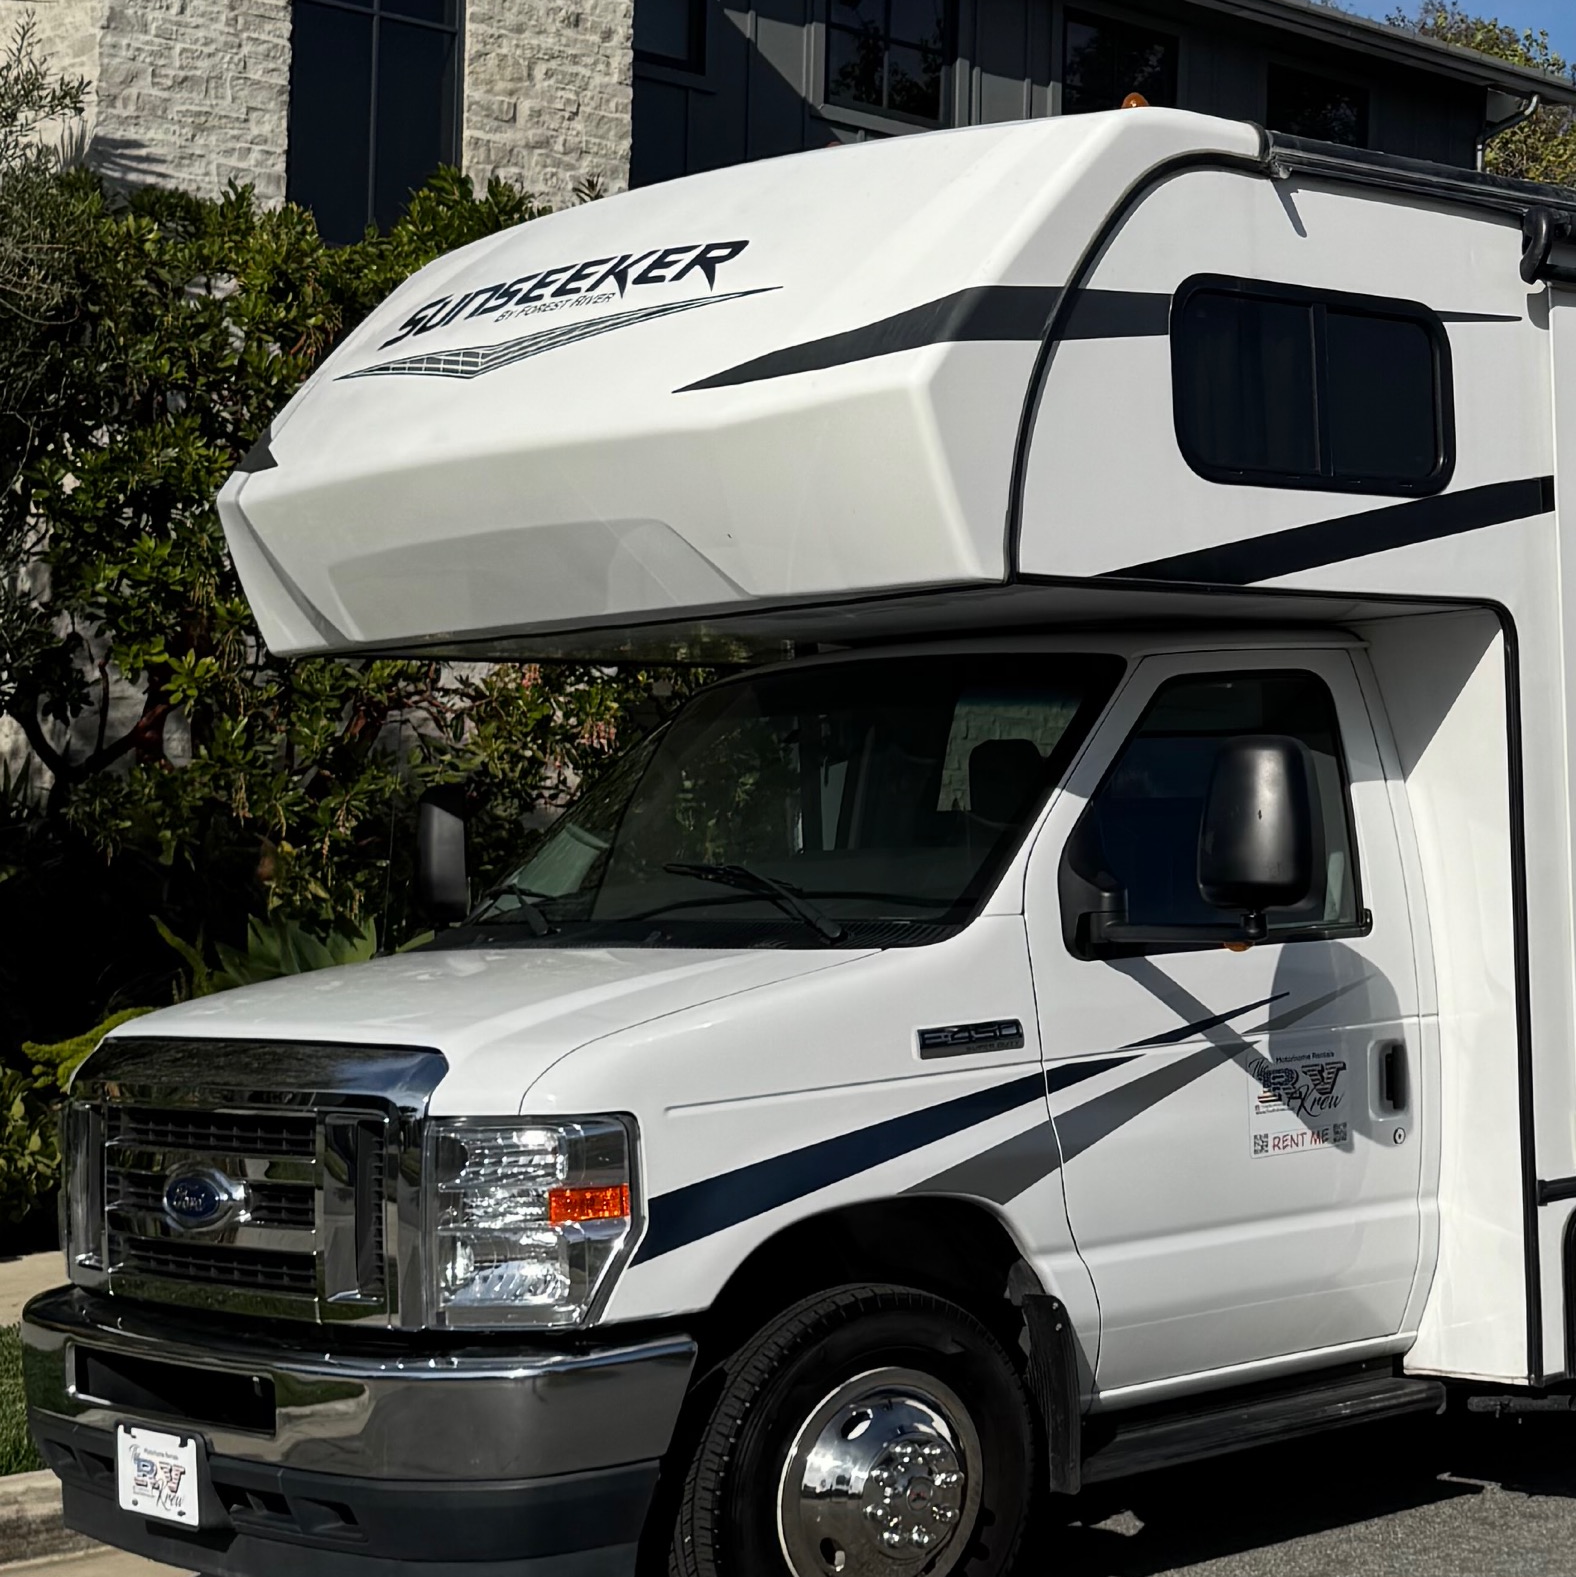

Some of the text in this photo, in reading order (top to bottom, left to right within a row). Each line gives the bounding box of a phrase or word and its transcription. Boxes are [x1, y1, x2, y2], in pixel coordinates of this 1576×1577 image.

[377, 239, 750, 351] SUNSEEKER
[493, 292, 616, 323] BY FOREST RIVER
[1257, 1061, 1347, 1104] RV
[1272, 1128, 1330, 1152] RENT ME
